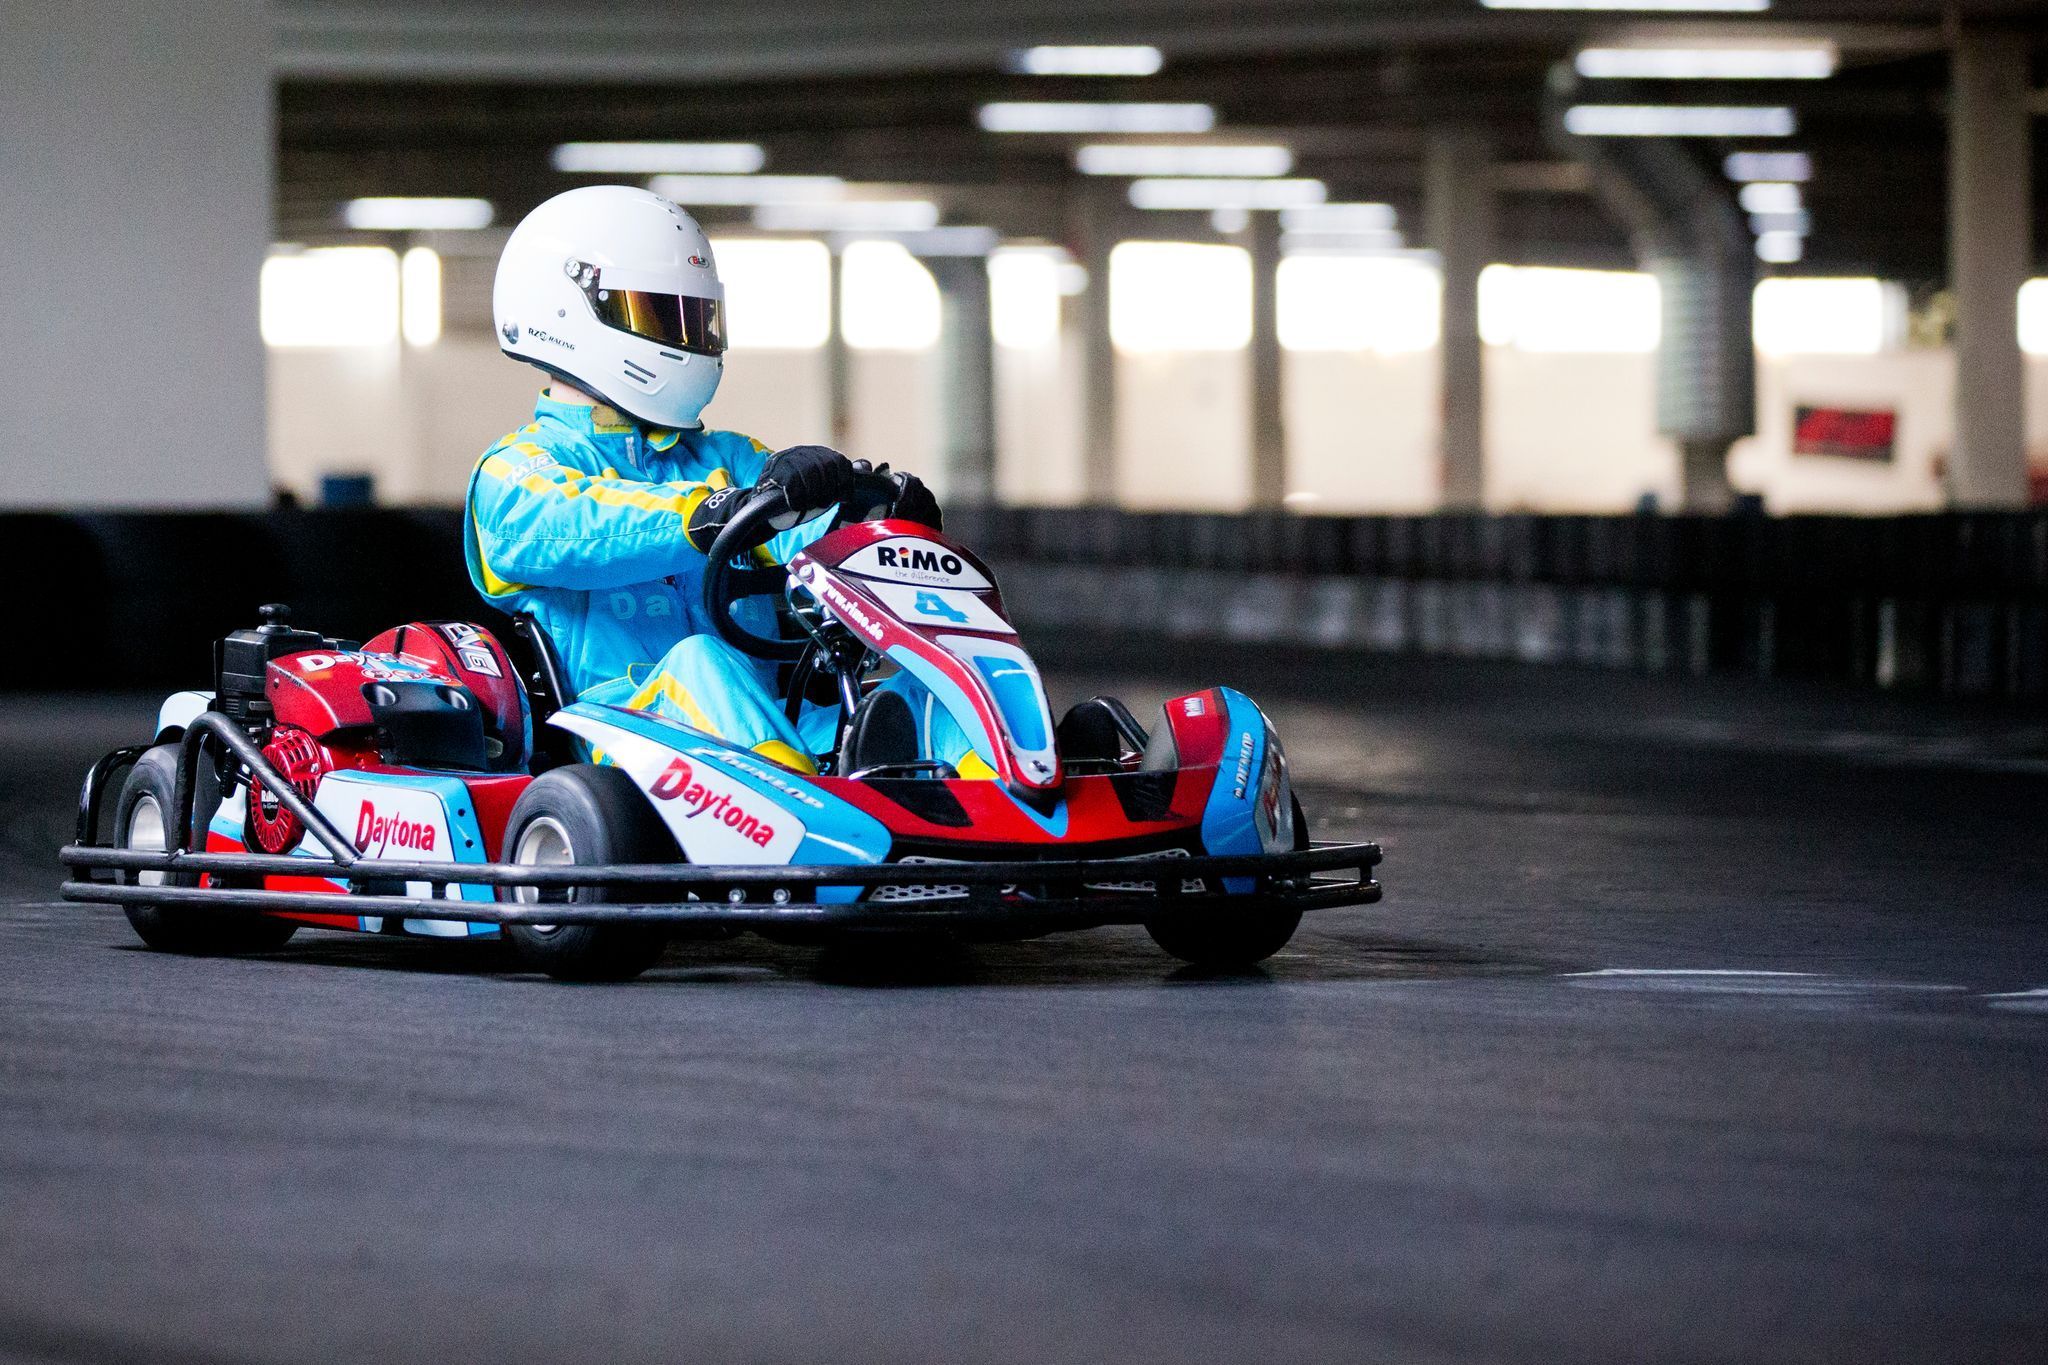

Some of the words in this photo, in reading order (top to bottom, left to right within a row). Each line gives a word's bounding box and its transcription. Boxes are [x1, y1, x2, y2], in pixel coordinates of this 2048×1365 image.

[914, 590, 970, 623] 4
[355, 799, 436, 859] Daytona
[649, 757, 775, 848] Daytona
